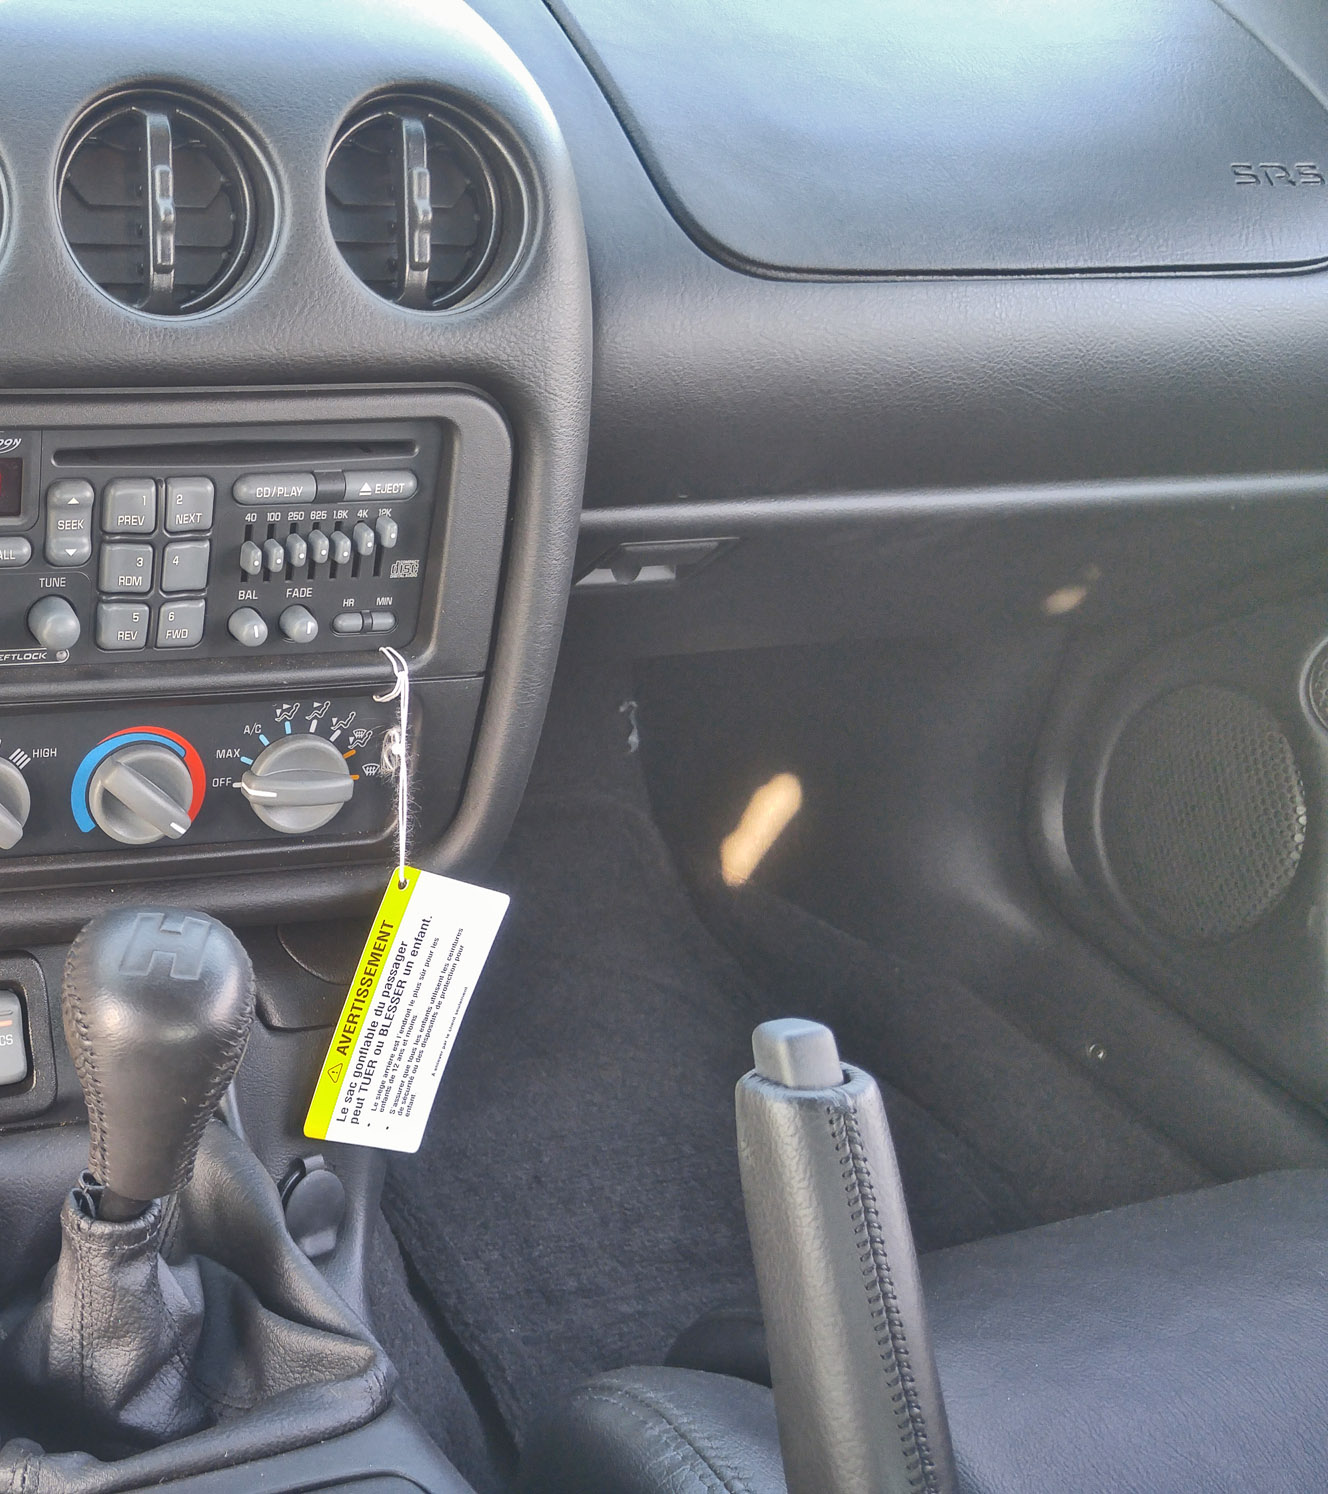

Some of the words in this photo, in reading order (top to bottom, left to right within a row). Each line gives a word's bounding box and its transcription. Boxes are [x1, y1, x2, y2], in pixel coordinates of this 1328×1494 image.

[1230, 162, 1325, 187] SRS
[256, 486, 304, 498] CD/PLAY
[374, 483, 405, 494] EJECT
[176, 494, 183, 505] 2
[117, 515, 145, 526] PREV
[175, 513, 203, 524] NEXT
[244, 513, 257, 522] 40
[266, 512, 281, 522] 100
[357, 509, 369, 519] 4K
[57, 520, 84, 530] SEEK
[136, 557, 144, 567] 3
[172, 555, 180, 566] 4
[39, 577, 66, 588] TUNE
[118, 576, 142, 586] RDM
[238, 590, 258, 600] BAL
[286, 588, 313, 598] FADE
[343, 598, 355, 607] HR
[376, 597, 393, 606] MIN
[132, 612, 140, 622] 5
[168, 611, 175, 621] 6
[117, 630, 138, 641] REV
[166, 629, 188, 640] FWD
[243, 723, 262, 736] A/C
[32, 748, 57, 759] HIGH
[216, 748, 241, 759] MAX
[212, 777, 232, 788] OFF
[410, 916, 433, 957] enfant.
[402, 960, 415, 976] un
[336, 919, 394, 1056] AVERTISSEMENT
[378, 979, 407, 1037] BLESSER
[336, 1107, 349, 1122] Le
[344, 1081, 358, 1104] sac
[352, 1020, 379, 1078] gonflable
[373, 1001, 386, 1017] du
[381, 940, 408, 999] passager
[373, 1040, 385, 1056] ou
[358, 1059, 378, 1093] TUER
[350, 1097, 366, 1125] peut
